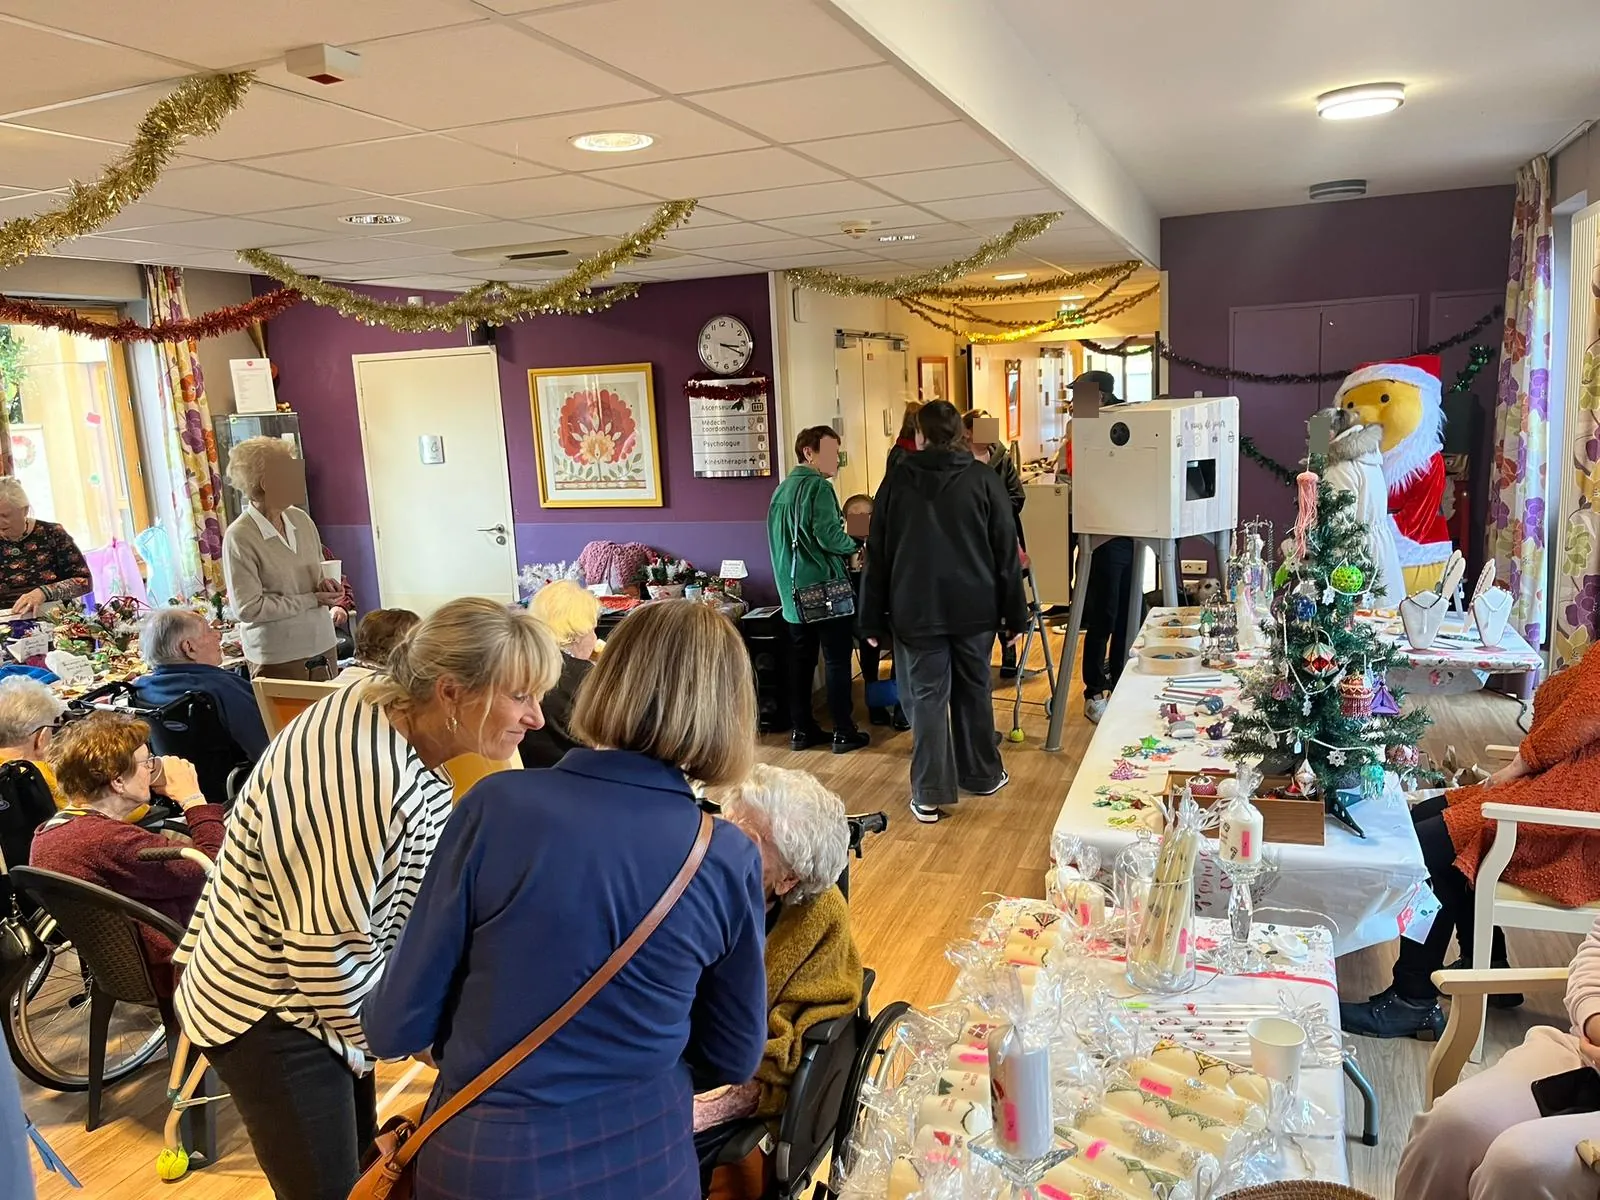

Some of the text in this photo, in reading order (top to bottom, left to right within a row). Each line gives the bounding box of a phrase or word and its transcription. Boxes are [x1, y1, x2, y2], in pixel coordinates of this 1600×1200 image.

[702, 425, 746, 433] coordonnateur
[703, 440, 740, 448] Psychologue
[704, 457, 747, 466] Kinésithérapie
